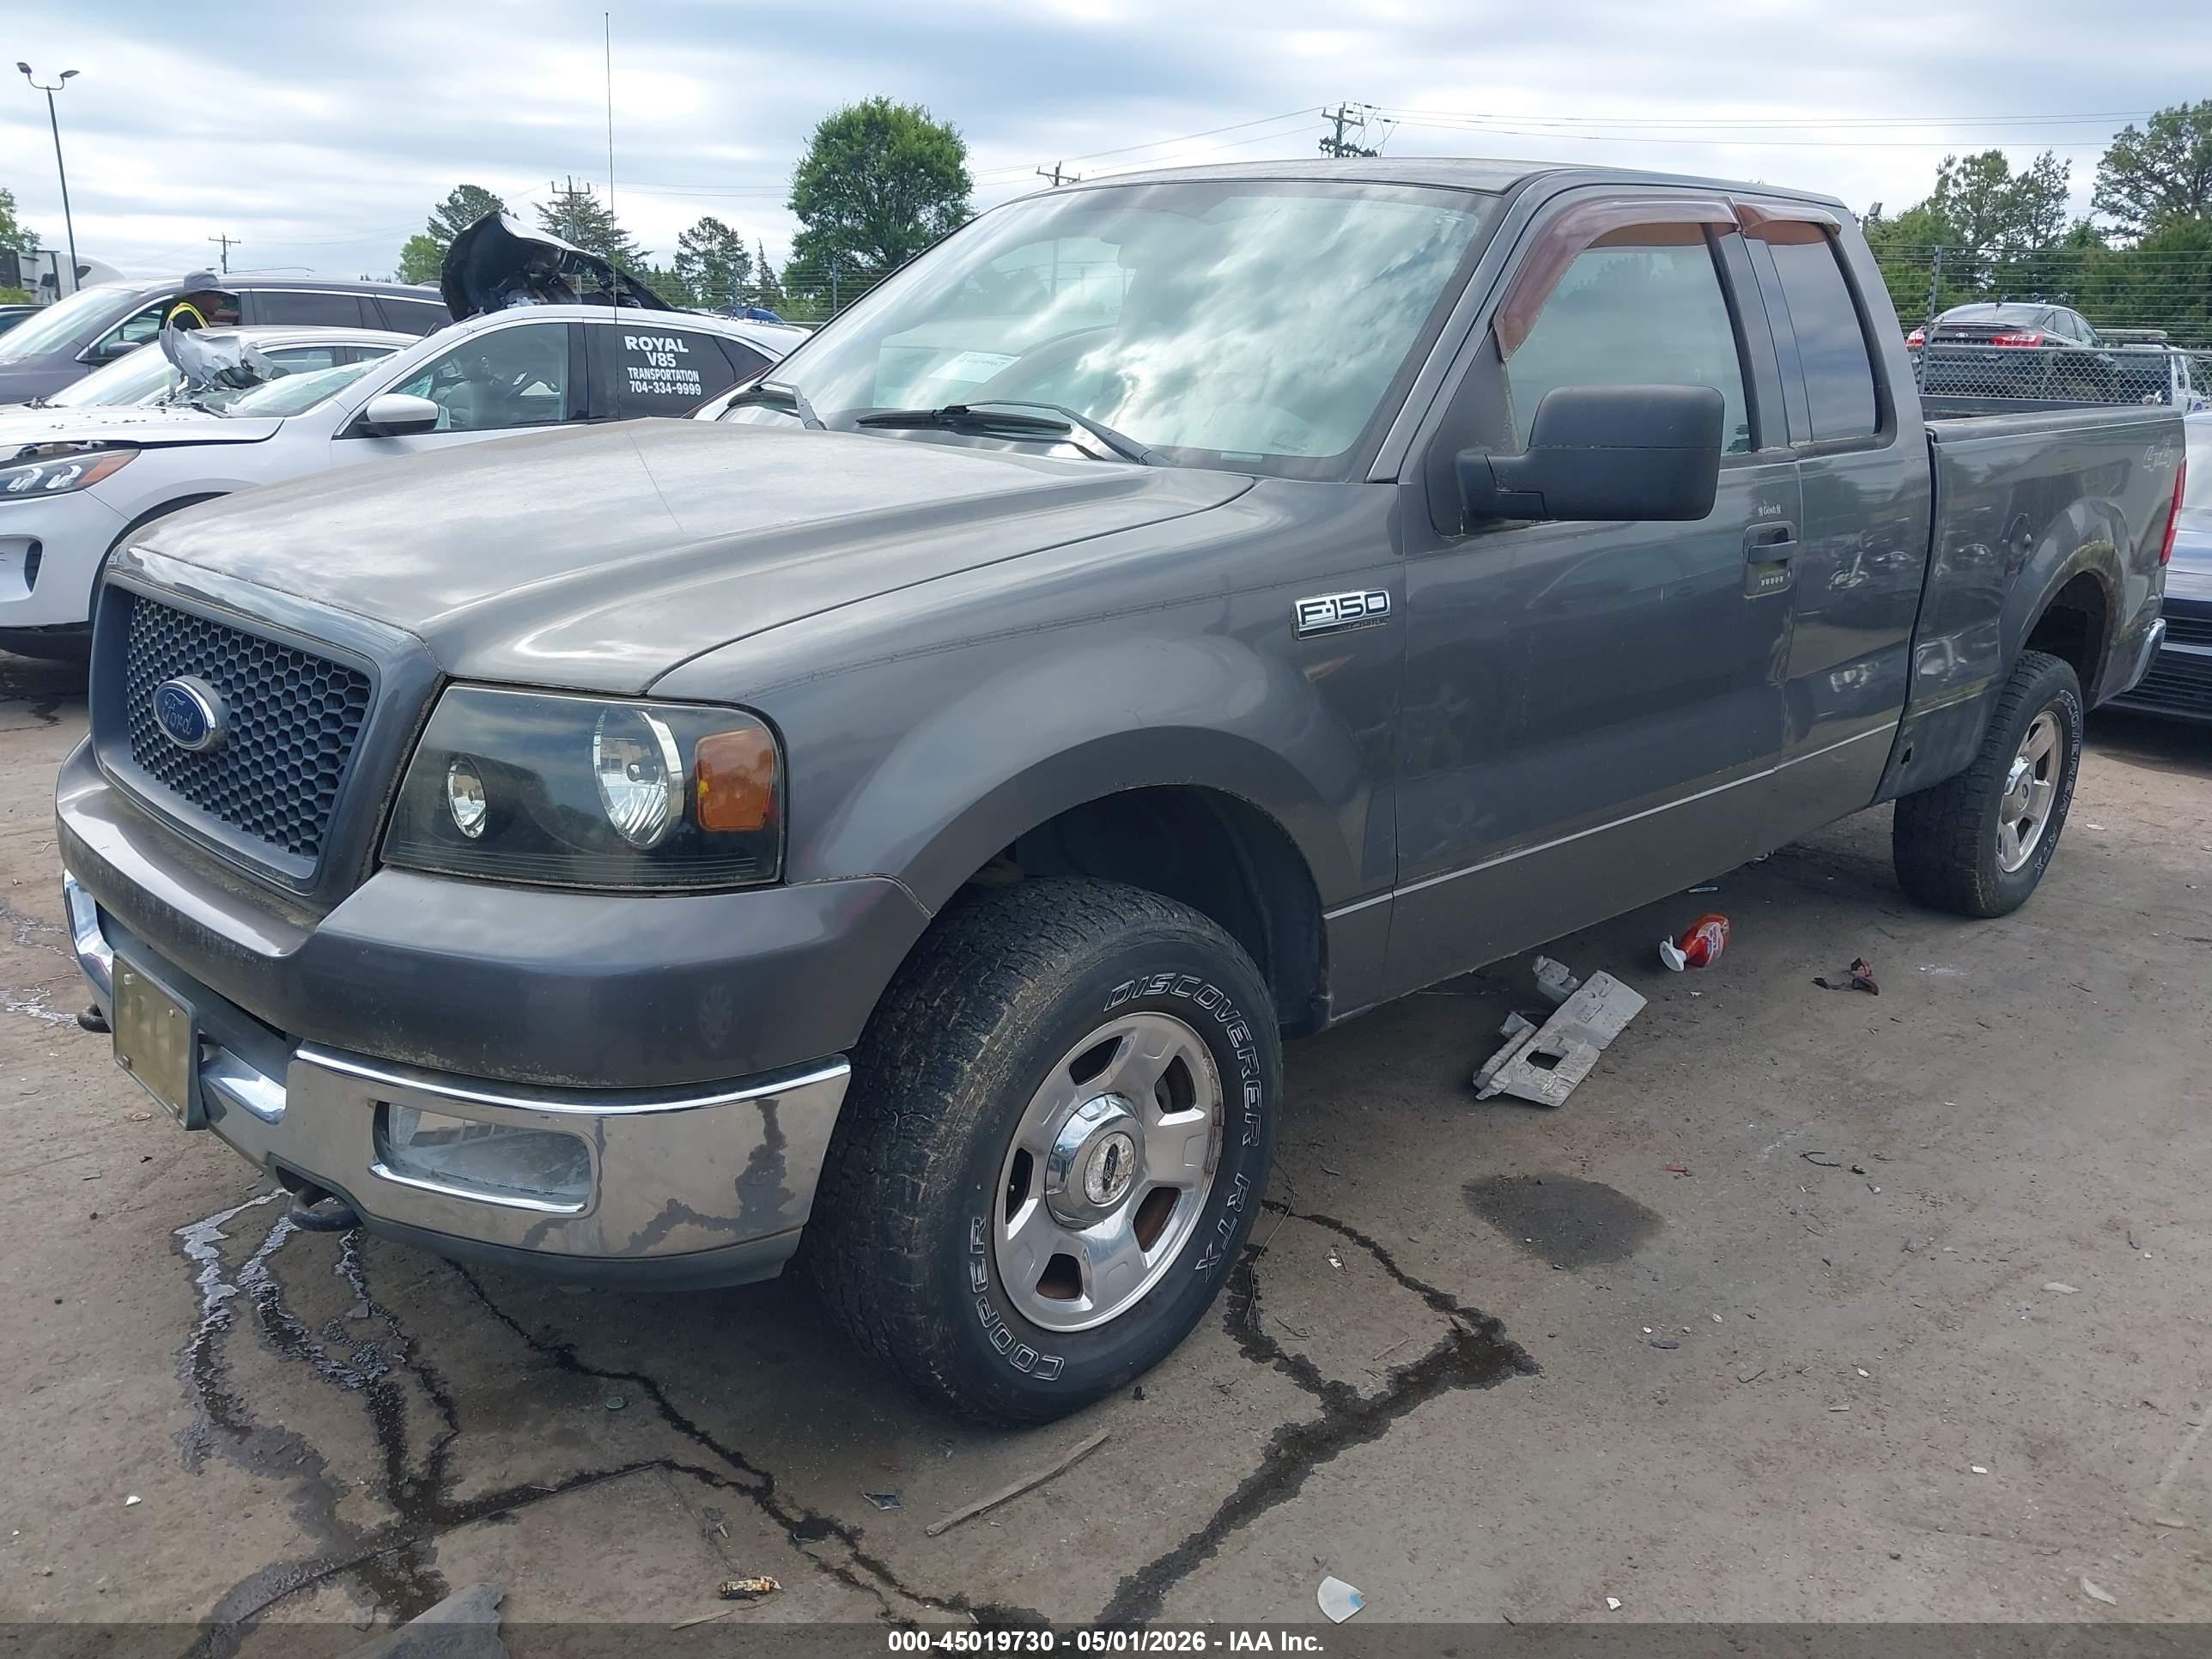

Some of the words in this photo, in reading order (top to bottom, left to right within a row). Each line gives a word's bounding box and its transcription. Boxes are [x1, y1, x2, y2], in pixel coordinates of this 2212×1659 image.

[623, 335, 690, 353] ROYAL
[645, 351, 677, 368] V85
[627, 367, 701, 382] TRANSPORTATION
[629, 380, 702, 396] 704-334-9999
[1297, 589, 1389, 626] F-150
[161, 692, 194, 736] Ford
[1103, 972, 1262, 1148] DISCOVERER
[1194, 1171, 1250, 1284] RTX
[969, 1215, 1065, 1382] COOPER
